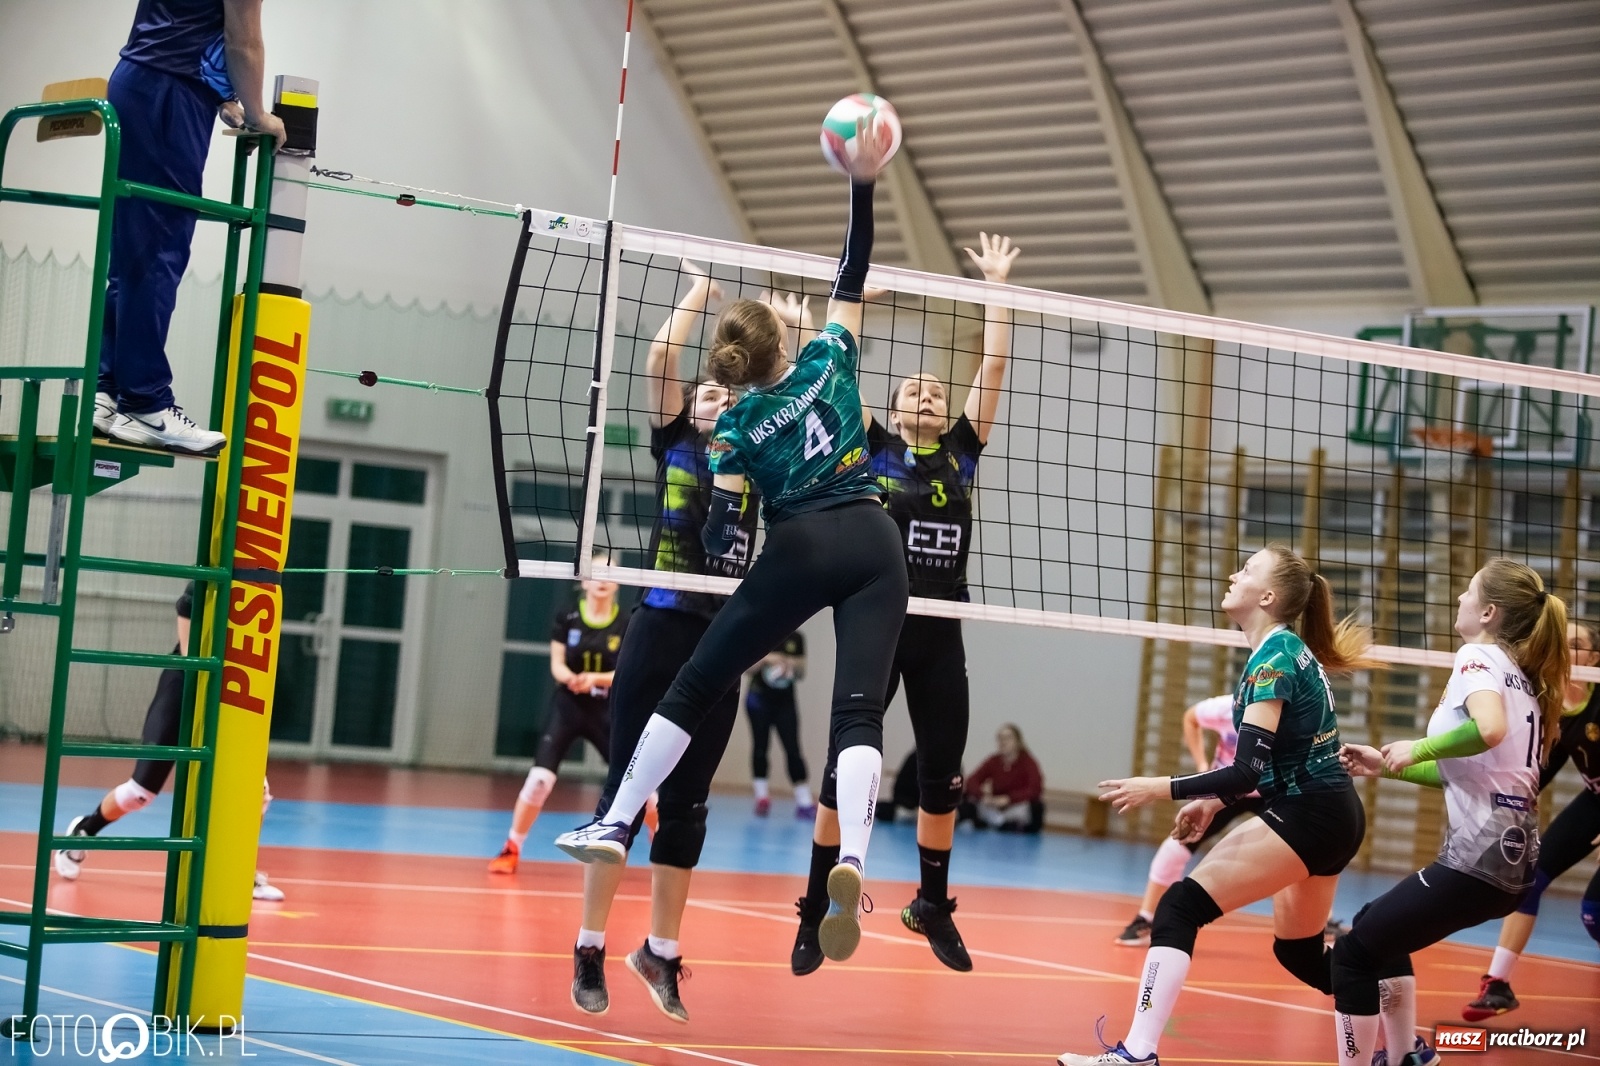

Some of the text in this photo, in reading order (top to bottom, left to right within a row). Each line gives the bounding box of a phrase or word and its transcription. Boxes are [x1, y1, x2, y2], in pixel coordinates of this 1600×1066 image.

[748, 418, 777, 445] UKS
[803, 409, 835, 461] 4
[930, 479, 948, 508] 3
[220, 331, 302, 715] PESMENPOL
